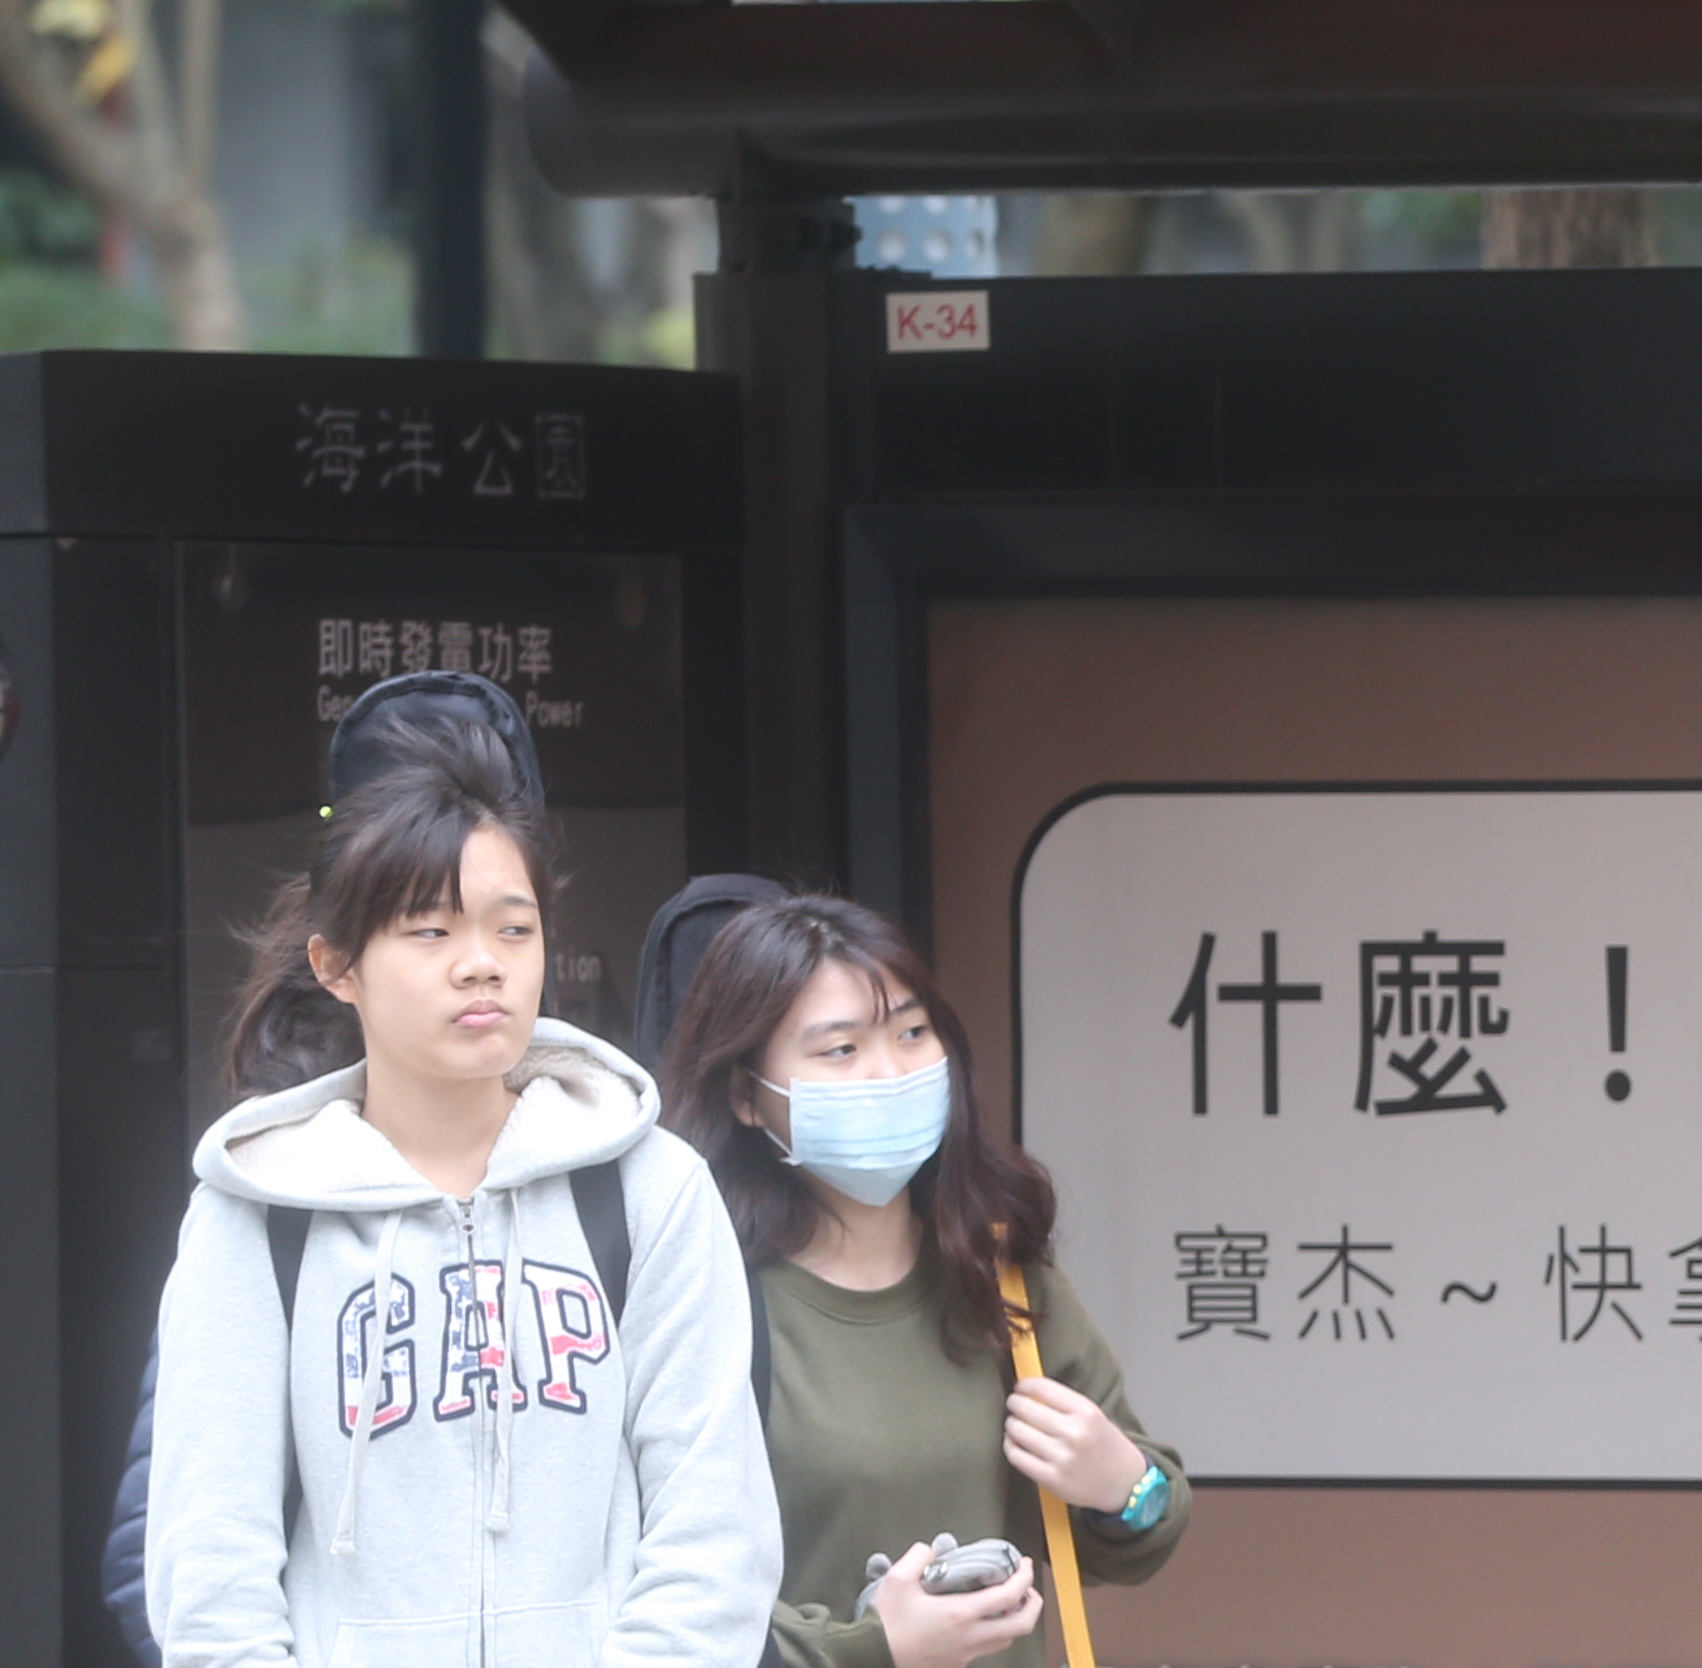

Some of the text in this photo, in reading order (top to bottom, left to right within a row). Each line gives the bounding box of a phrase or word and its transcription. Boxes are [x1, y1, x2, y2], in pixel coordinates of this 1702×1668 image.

[897, 303, 978, 340] K-34
[295, 403, 585, 499] 海洋公園
[318, 617, 552, 683] 即時發電功率
[337, 1258, 610, 1442] GAP
